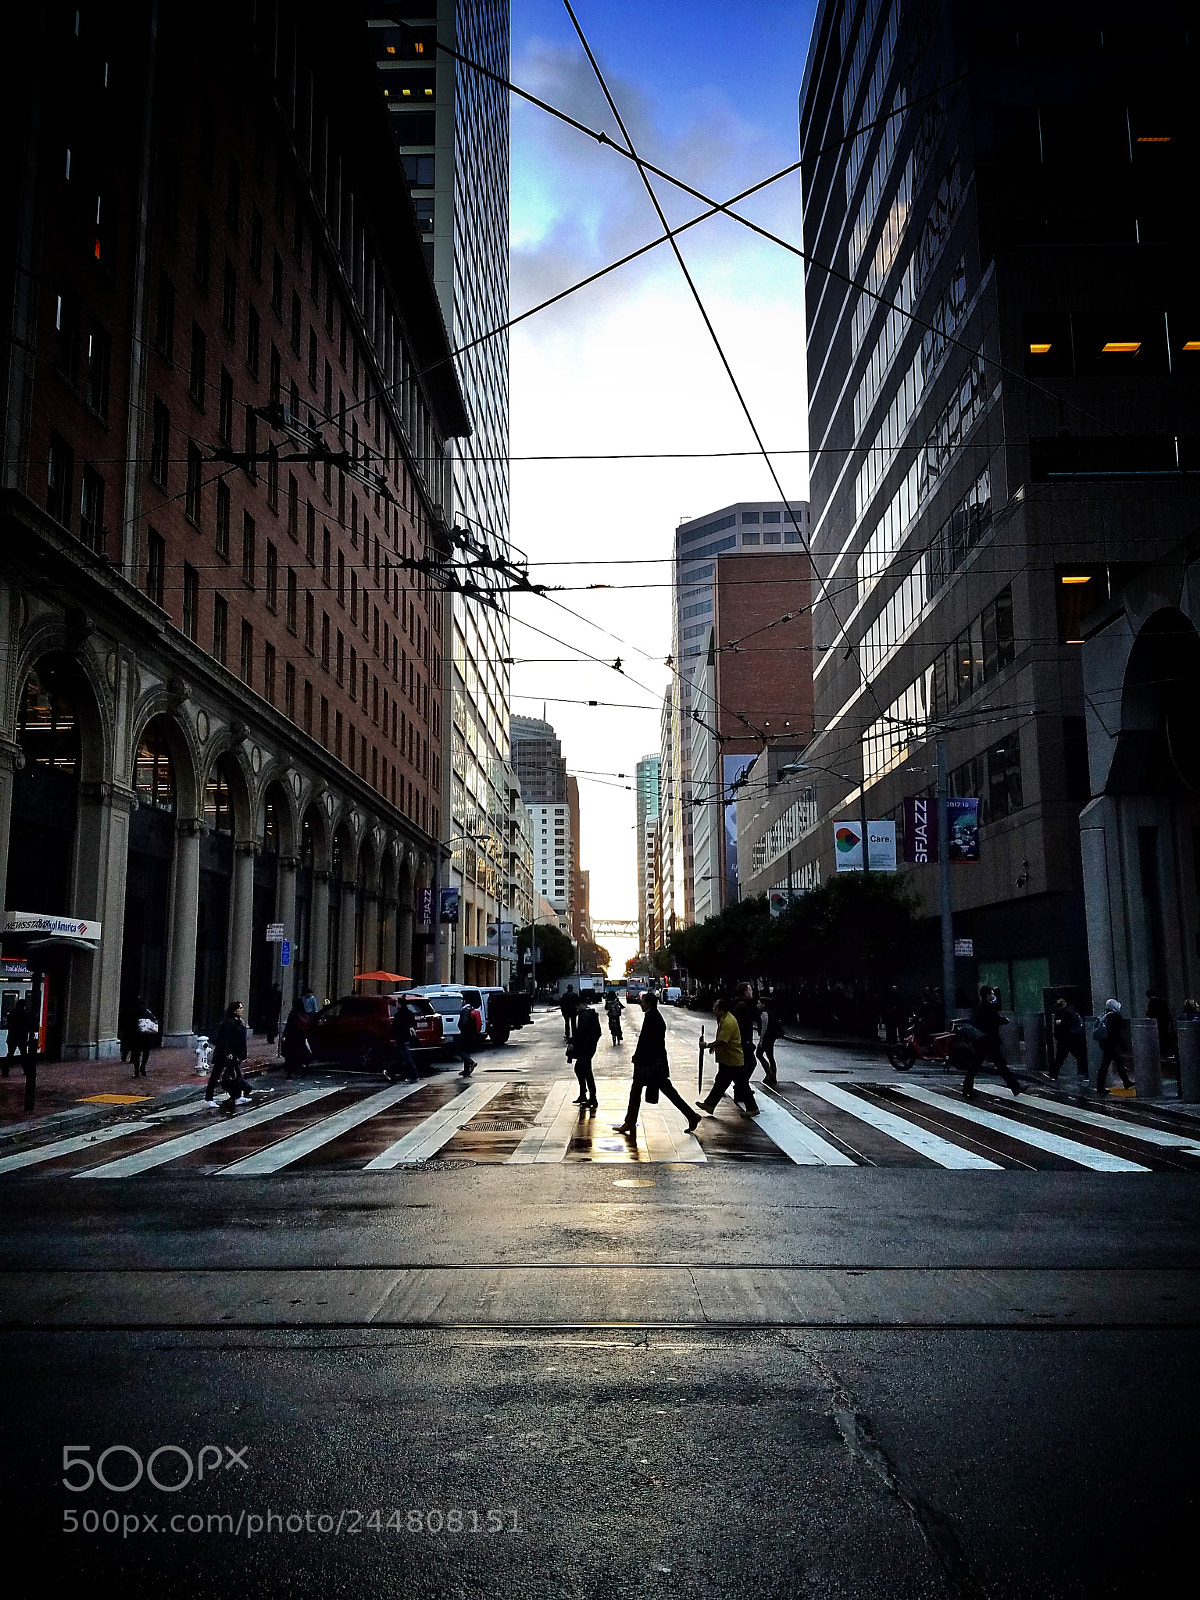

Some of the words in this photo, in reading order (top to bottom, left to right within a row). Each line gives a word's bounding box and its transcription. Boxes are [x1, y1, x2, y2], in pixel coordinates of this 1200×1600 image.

[870, 834, 892, 843] Care.
[914, 799, 928, 863] SFJAZZ
[423, 889, 432, 925] SFJAZZ
